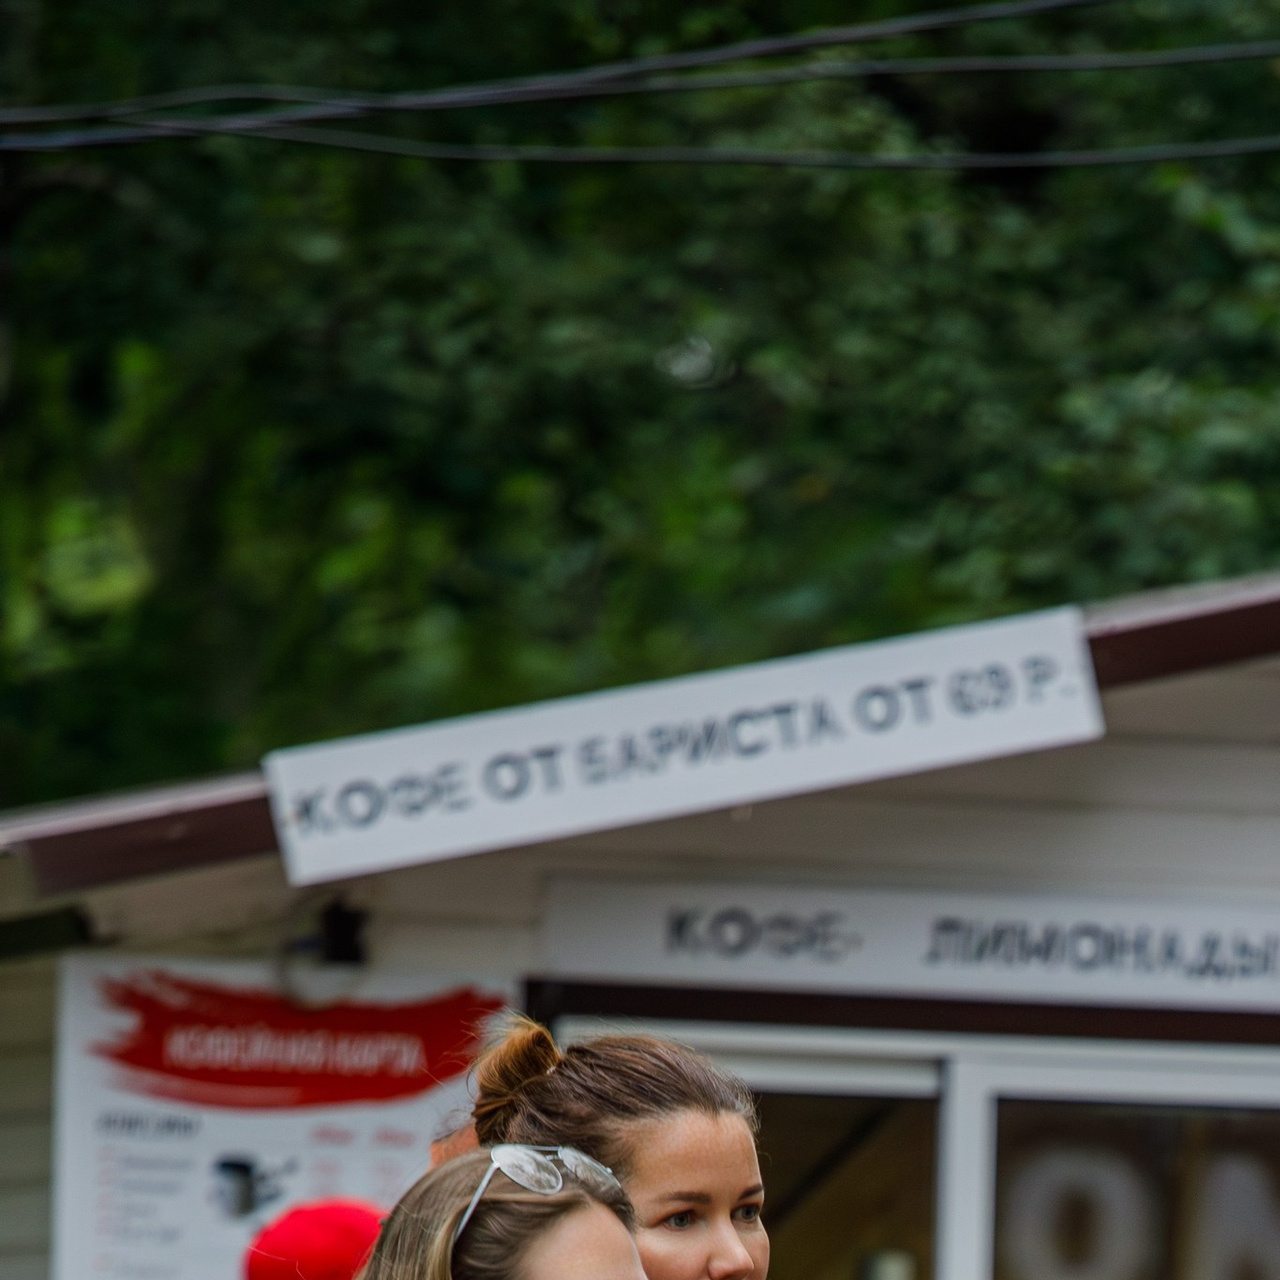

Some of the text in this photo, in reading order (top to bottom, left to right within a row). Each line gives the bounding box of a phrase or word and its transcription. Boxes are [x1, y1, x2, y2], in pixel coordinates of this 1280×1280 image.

[290, 760, 474, 835] КОФЕ
[481, 745, 570, 804] ОТ
[575, 703, 846, 788] БАРИСТА
[853, 676, 938, 734] ОТ
